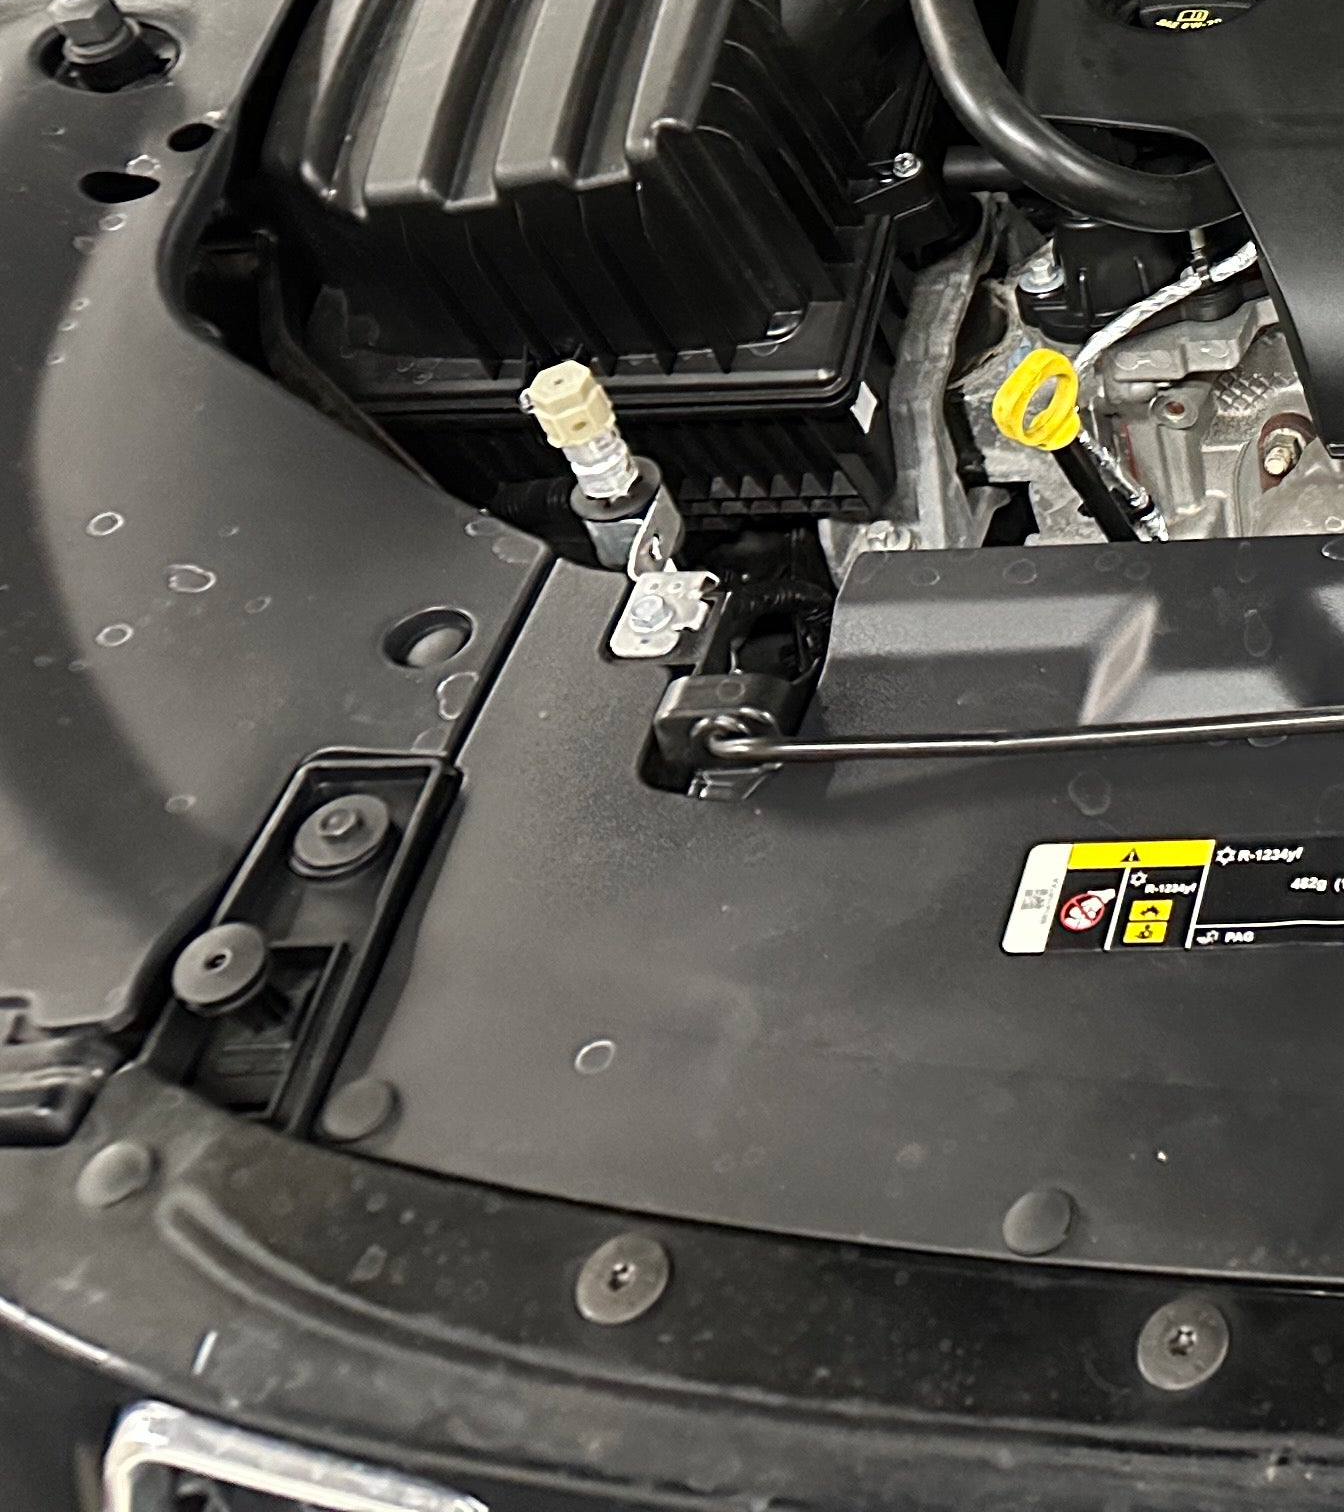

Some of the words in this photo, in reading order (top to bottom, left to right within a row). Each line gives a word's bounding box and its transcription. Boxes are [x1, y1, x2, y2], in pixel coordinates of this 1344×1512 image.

[1237, 845, 1305, 864] R-1234yf
[1144, 882, 1199, 896] R-1234yf
[1223, 931, 1256, 943] PAG
